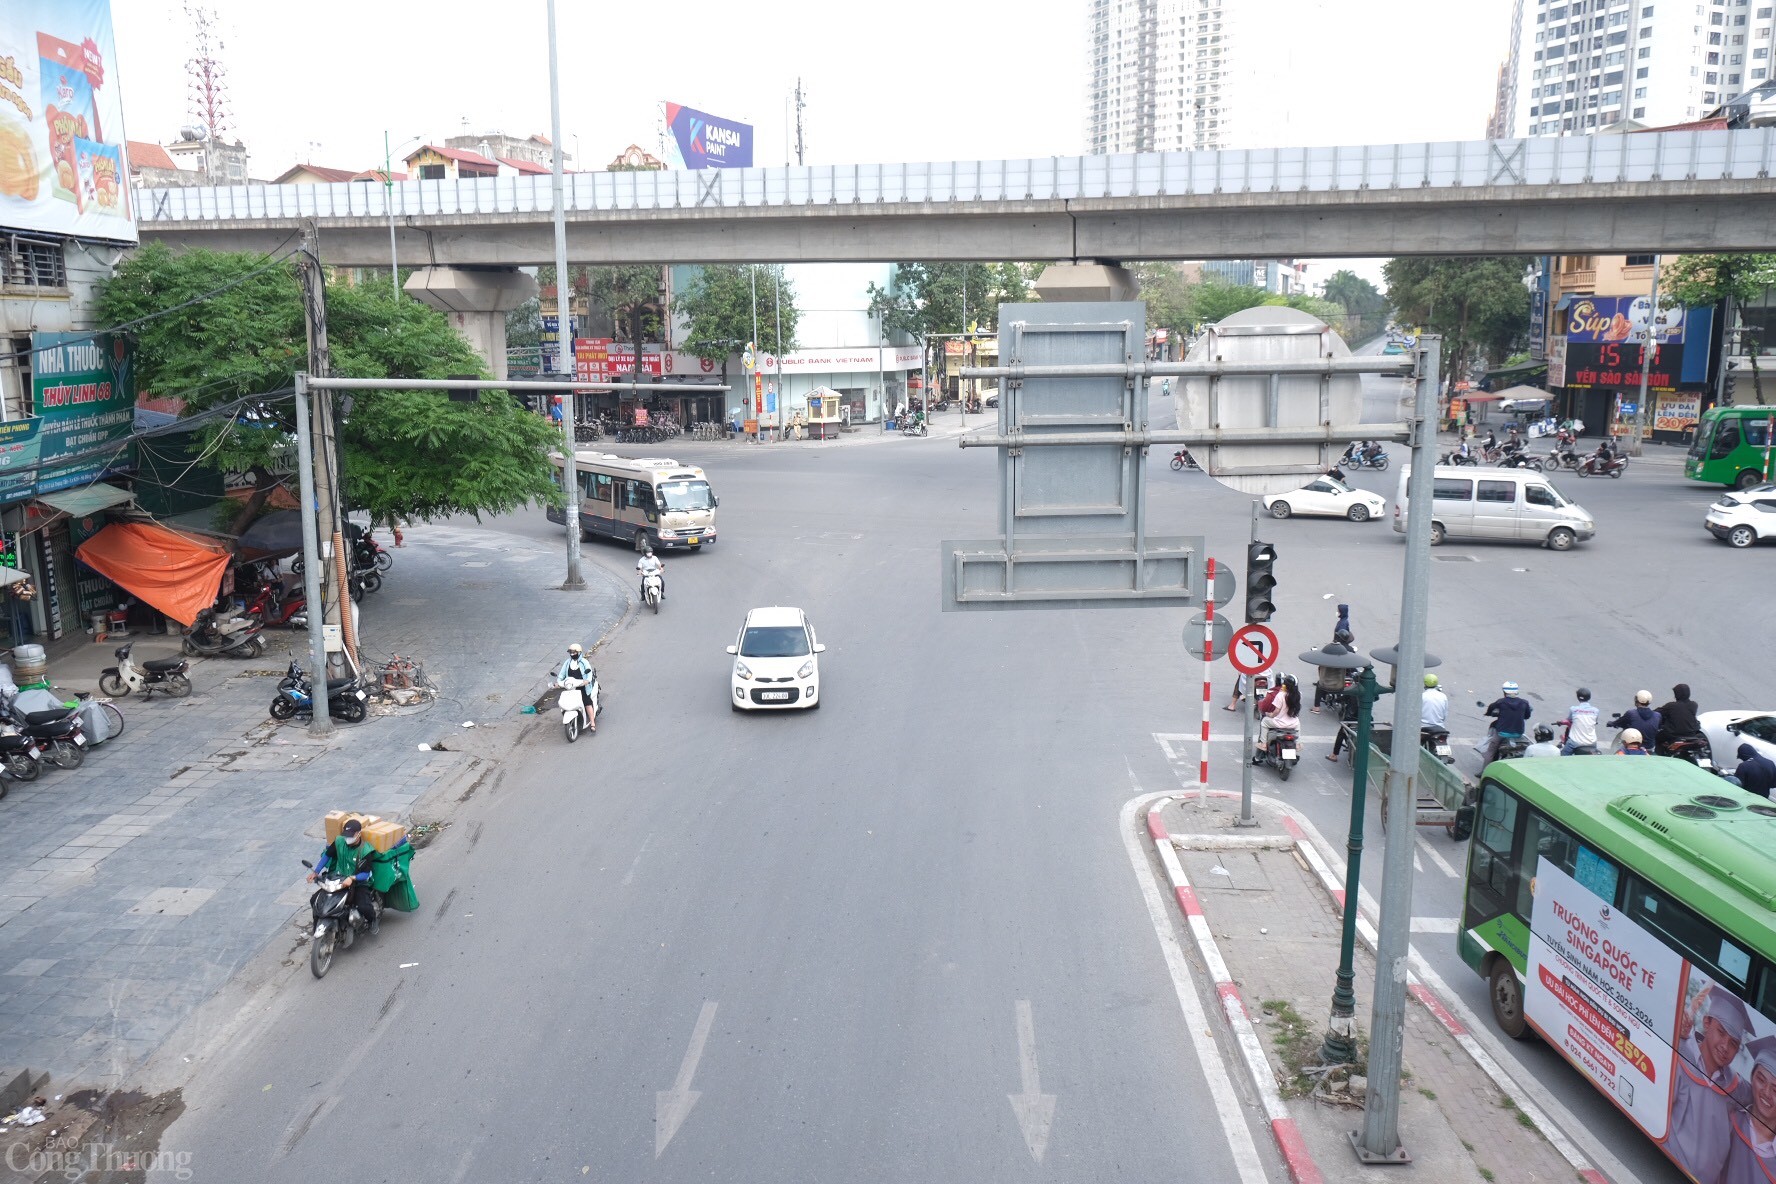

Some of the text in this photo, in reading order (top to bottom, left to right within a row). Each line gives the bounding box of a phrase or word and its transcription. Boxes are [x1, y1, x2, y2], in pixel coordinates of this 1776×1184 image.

[705, 124, 740, 147] KANSAI
[706, 141, 726, 156] PAINT
[1638, 299, 1656, 309] Bà
[1570, 304, 1611, 340] Súp
[1655, 315, 1667, 324] Cá
[39, 341, 65, 373] NHÀ
[1600, 343, 1620, 366] 15
[1576, 366, 1597, 383] YẾN
[1600, 370, 1622, 385] SÀO
[72, 383, 97, 404] LINH
[97, 381, 111, 400] 68
[1657, 416, 1694, 432] 20%
[1553, 900, 1656, 990] TRƯỜNG QUỐC TẾ
[1566, 930, 1633, 992] SINGAPORE
[1547, 934, 1566, 955] TUYỂN
[1566, 951, 1582, 968] SINH
[1583, 964, 1599, 983] NĂM
[1600, 978, 1615, 995] HỌC
[1615, 991, 1653, 1027] 2025-2026
[1588, 981, 1602, 998] QUỐC
[1545, 975, 1554, 988] ƯU
[1554, 982, 1564, 997] ĐÃI
[1565, 993, 1578, 1010] HỌC
[1578, 1003, 1589, 1019] PHÍ
[1589, 1012, 1601, 1029] LÊN
[1600, 1022, 1614, 1041] ĐẾN
[1614, 1032, 1648, 1072] 25%
[1586, 1042, 1594, 1054] KÝ
[1570, 1044, 1616, 1091] 024 6661 7722
